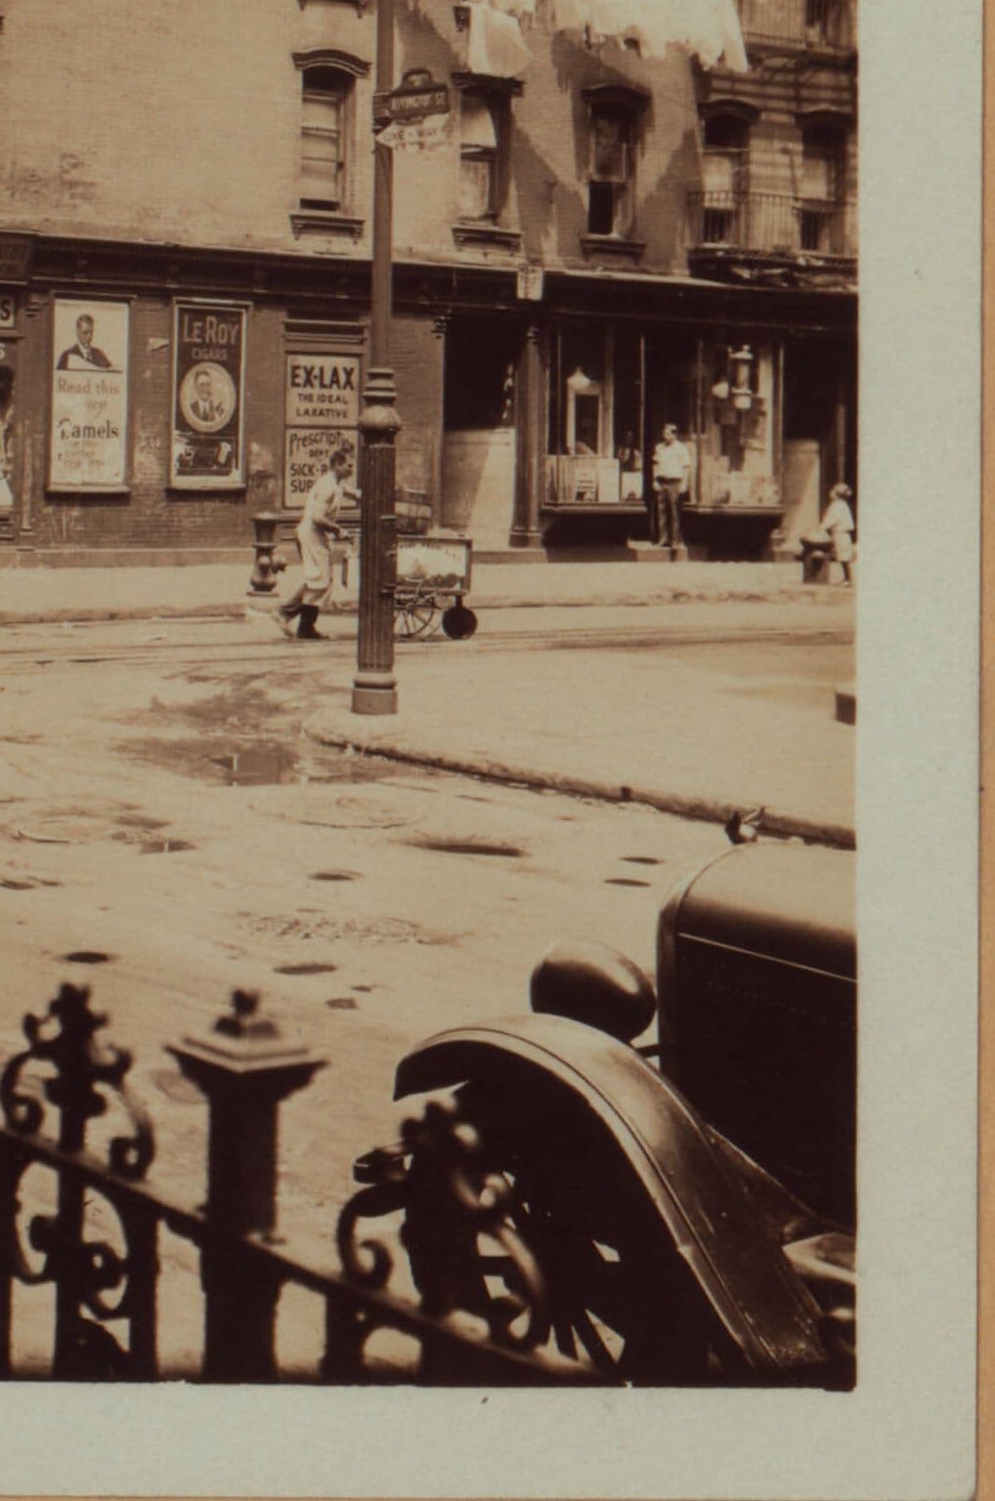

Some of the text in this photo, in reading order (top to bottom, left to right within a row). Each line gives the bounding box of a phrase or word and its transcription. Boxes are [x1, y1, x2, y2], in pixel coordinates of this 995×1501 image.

[191, 347, 228, 361] CIGARS
[290, 365, 355, 391] EX-LAX
[58, 379, 120, 397] Read this
[298, 393, 349, 405] THE IDEAL
[296, 408, 349, 419] LAXATIVE
[57, 418, 120, 441] Camels
